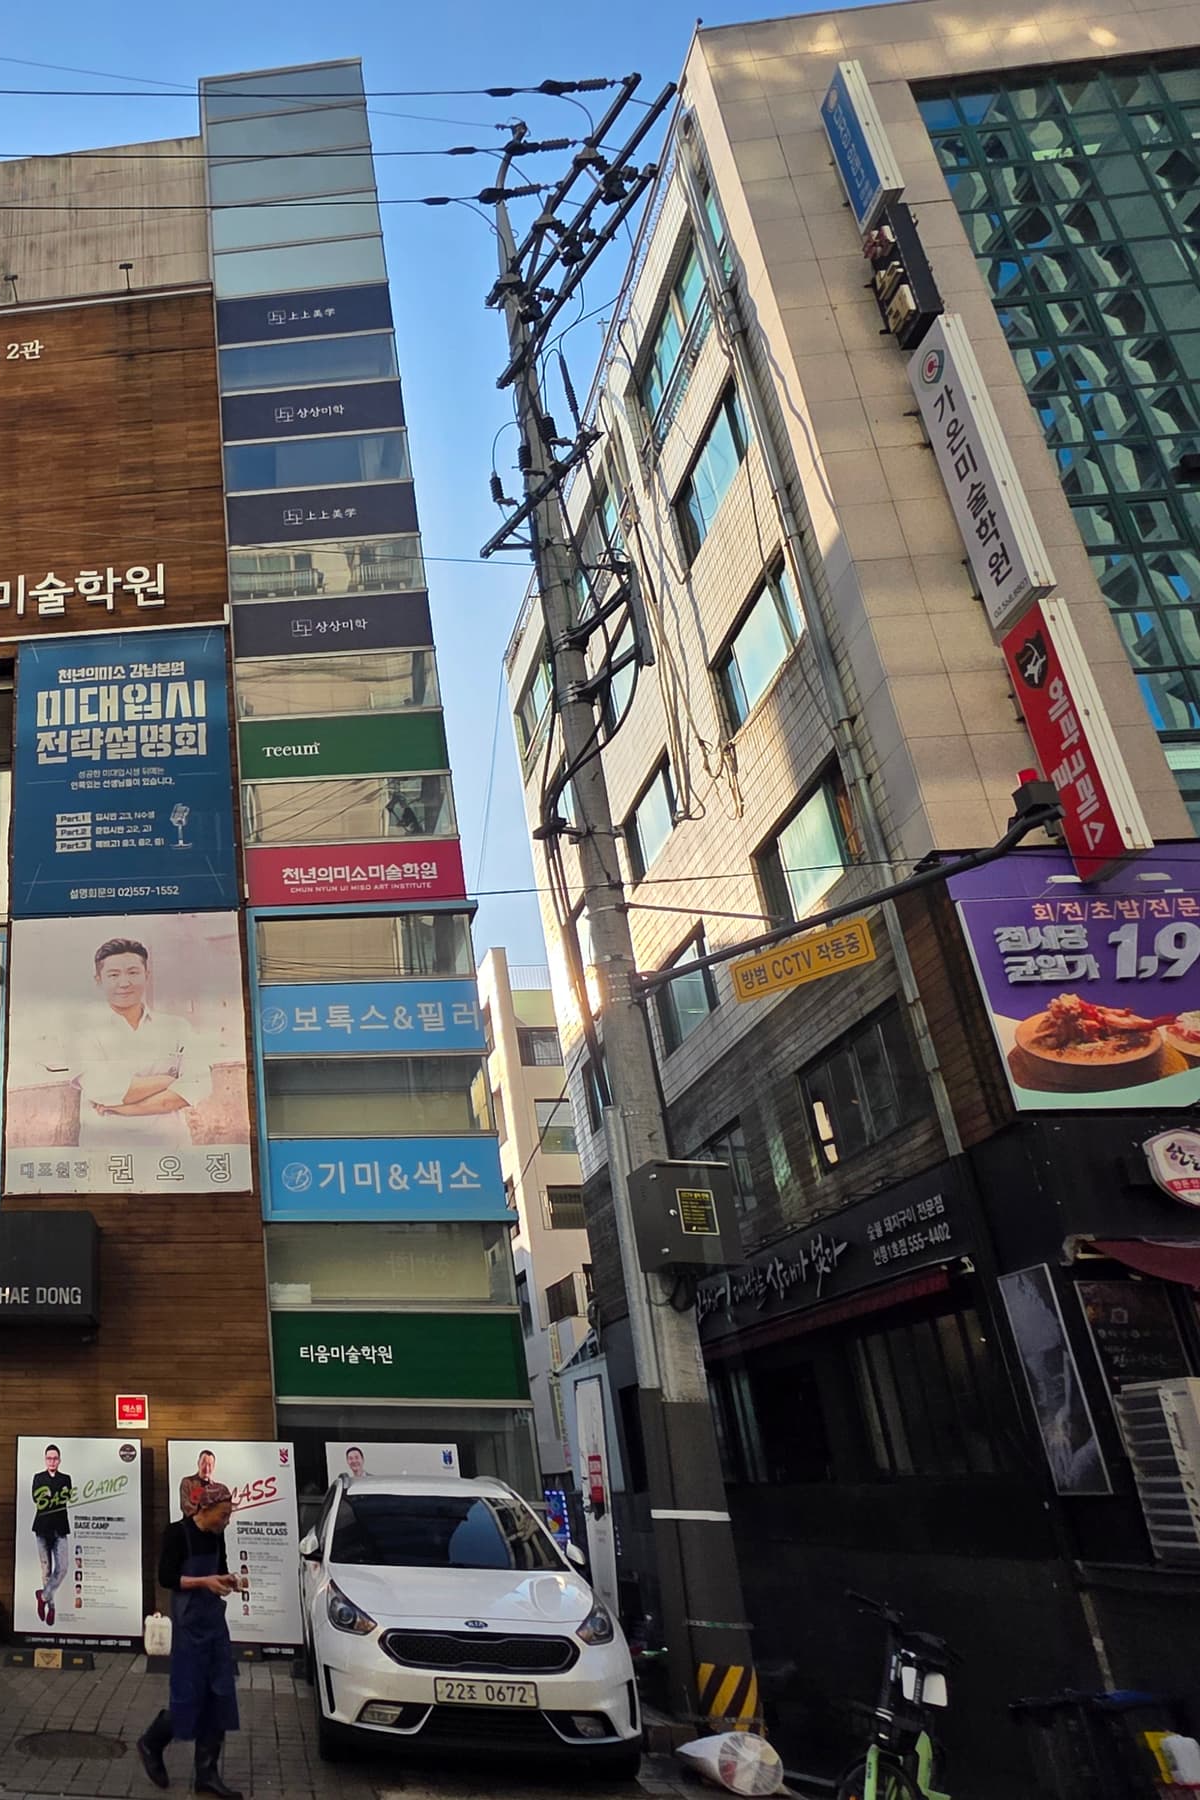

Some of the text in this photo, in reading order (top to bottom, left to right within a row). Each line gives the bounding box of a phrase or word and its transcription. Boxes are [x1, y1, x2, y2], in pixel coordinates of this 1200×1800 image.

[6, 339, 43, 361] 2관
[296, 404, 345, 419] 상상미학
[933, 384, 1013, 587] 가온미술학원
[315, 618, 368, 634] 상상미학
[58, 665, 126, 684] 천년의미소
[36, 679, 207, 728] 미대입시
[36, 722, 207, 765] 전략설명회
[282, 861, 438, 885] 천년의미소미술학원
[741, 932, 860, 991] 방범 CCTV 작동중
[292, 1001, 480, 1034] 보톡스&필러
[107, 1152, 233, 1184] 권오정
[318, 1160, 481, 1194] 기미&색소
[916, 1194, 945, 1222] 전문점
[907, 1221, 951, 1253] 555-4402
[36, 1287, 82, 1305] DONG
[299, 1345, 393, 1364] 티움미술학원
[236, 1526, 288, 1536] SPECIAL CLASS
[445, 1682, 527, 1703] 22조 0672
